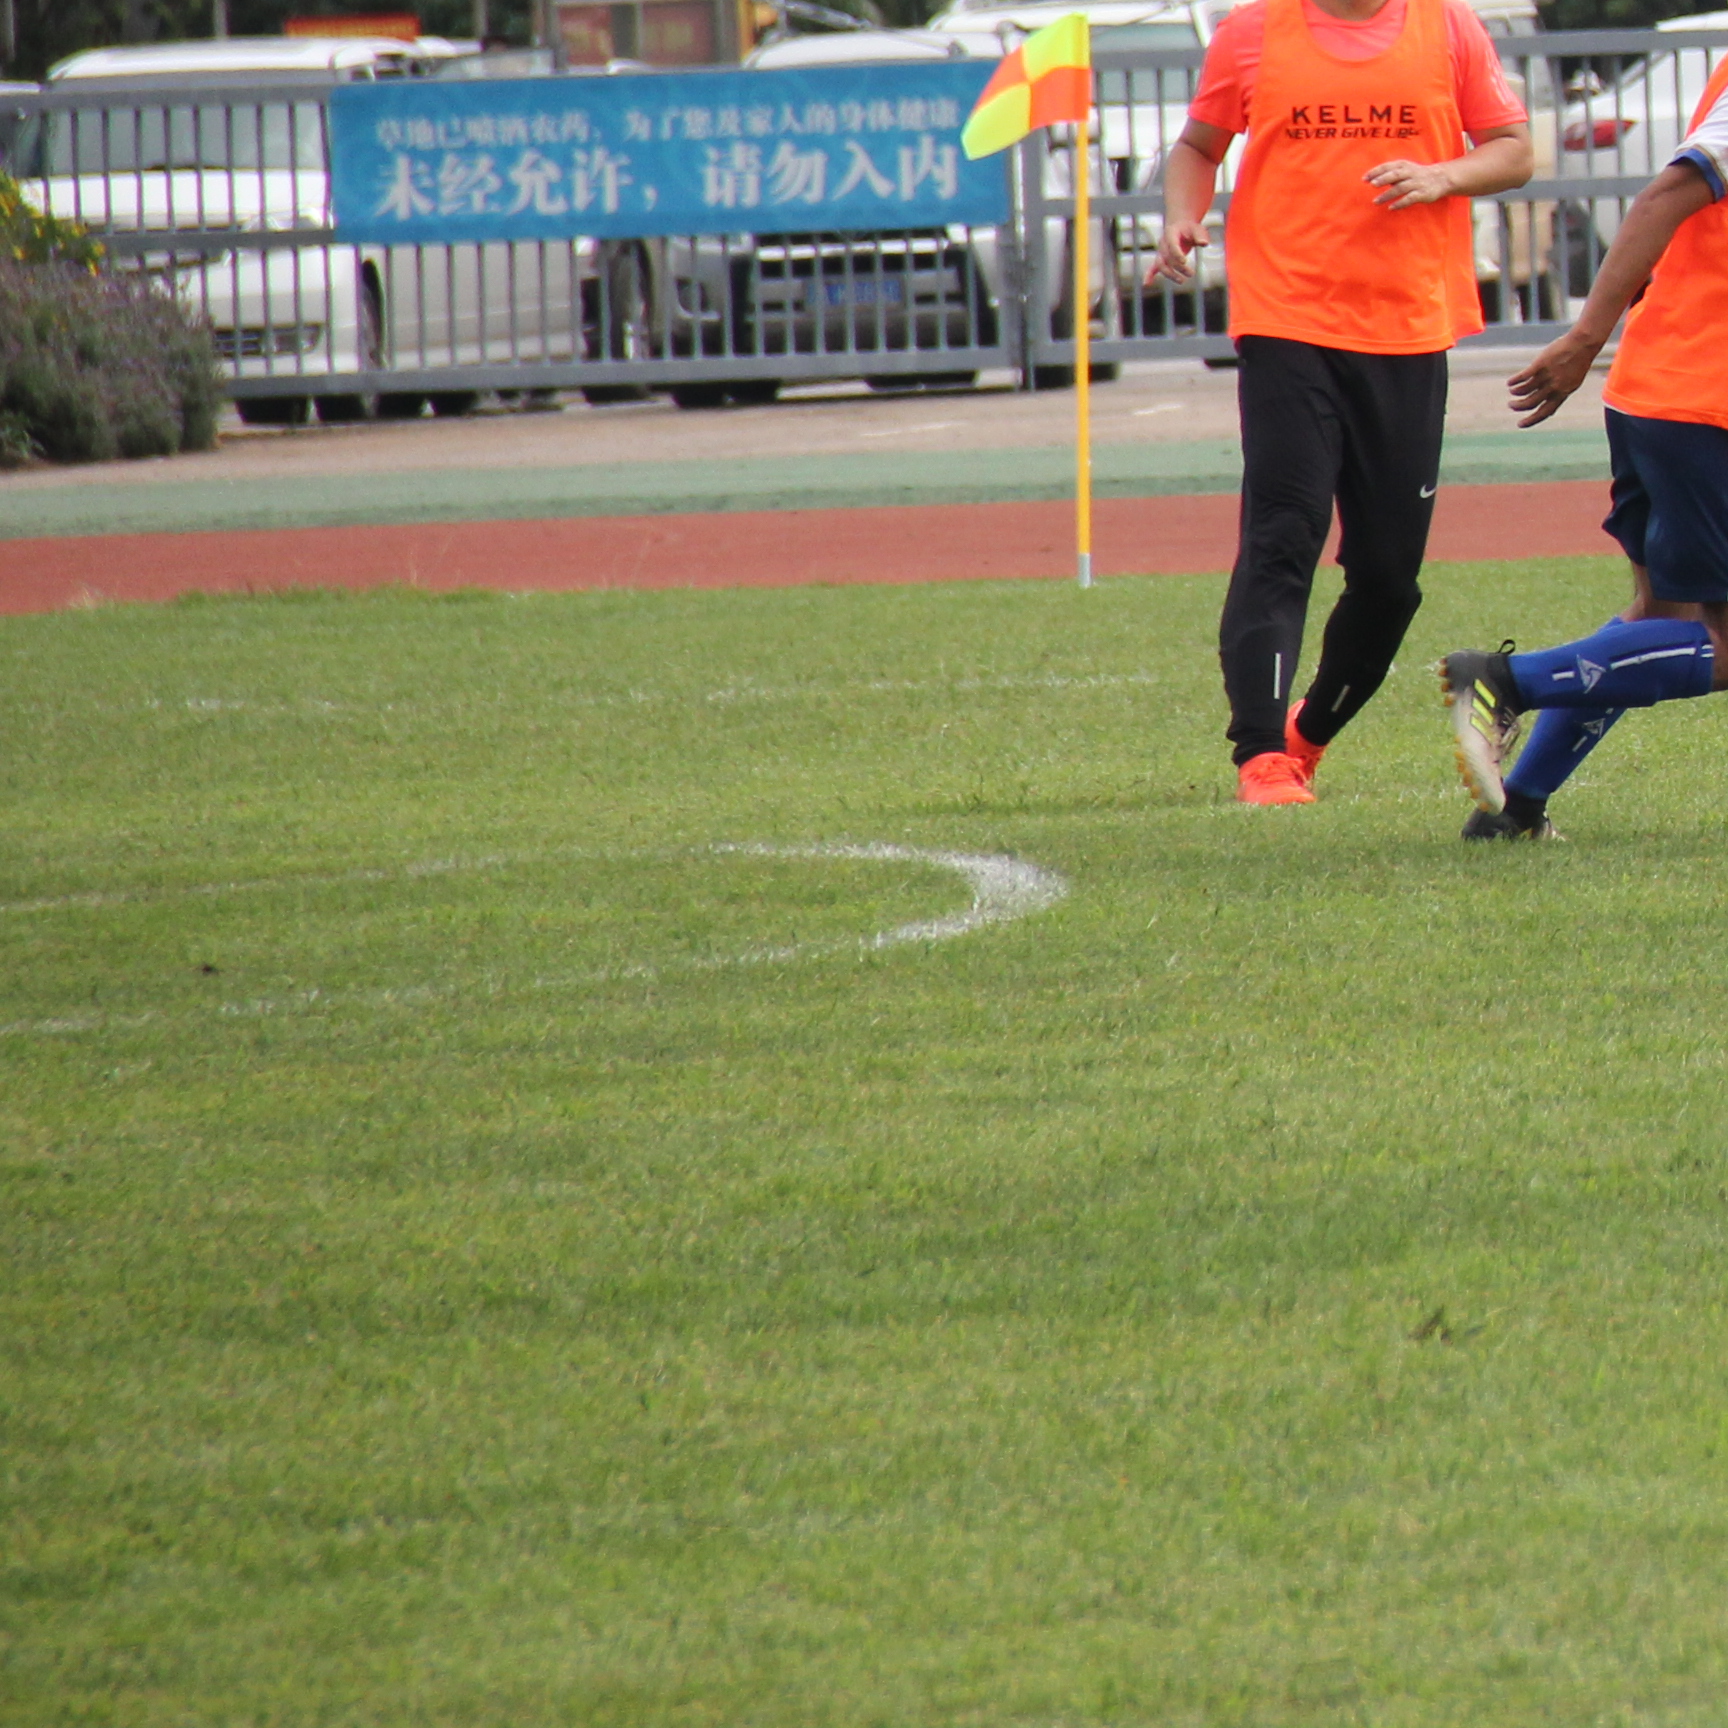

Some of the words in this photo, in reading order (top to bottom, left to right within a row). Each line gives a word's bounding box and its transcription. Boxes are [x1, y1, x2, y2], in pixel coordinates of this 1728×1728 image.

[1292, 105, 1417, 124] KELME
[1286, 127, 1337, 140] NEVER
[1341, 127, 1384, 139] GIVE
[375, 133, 958, 221] 未经允许，请勿入内
